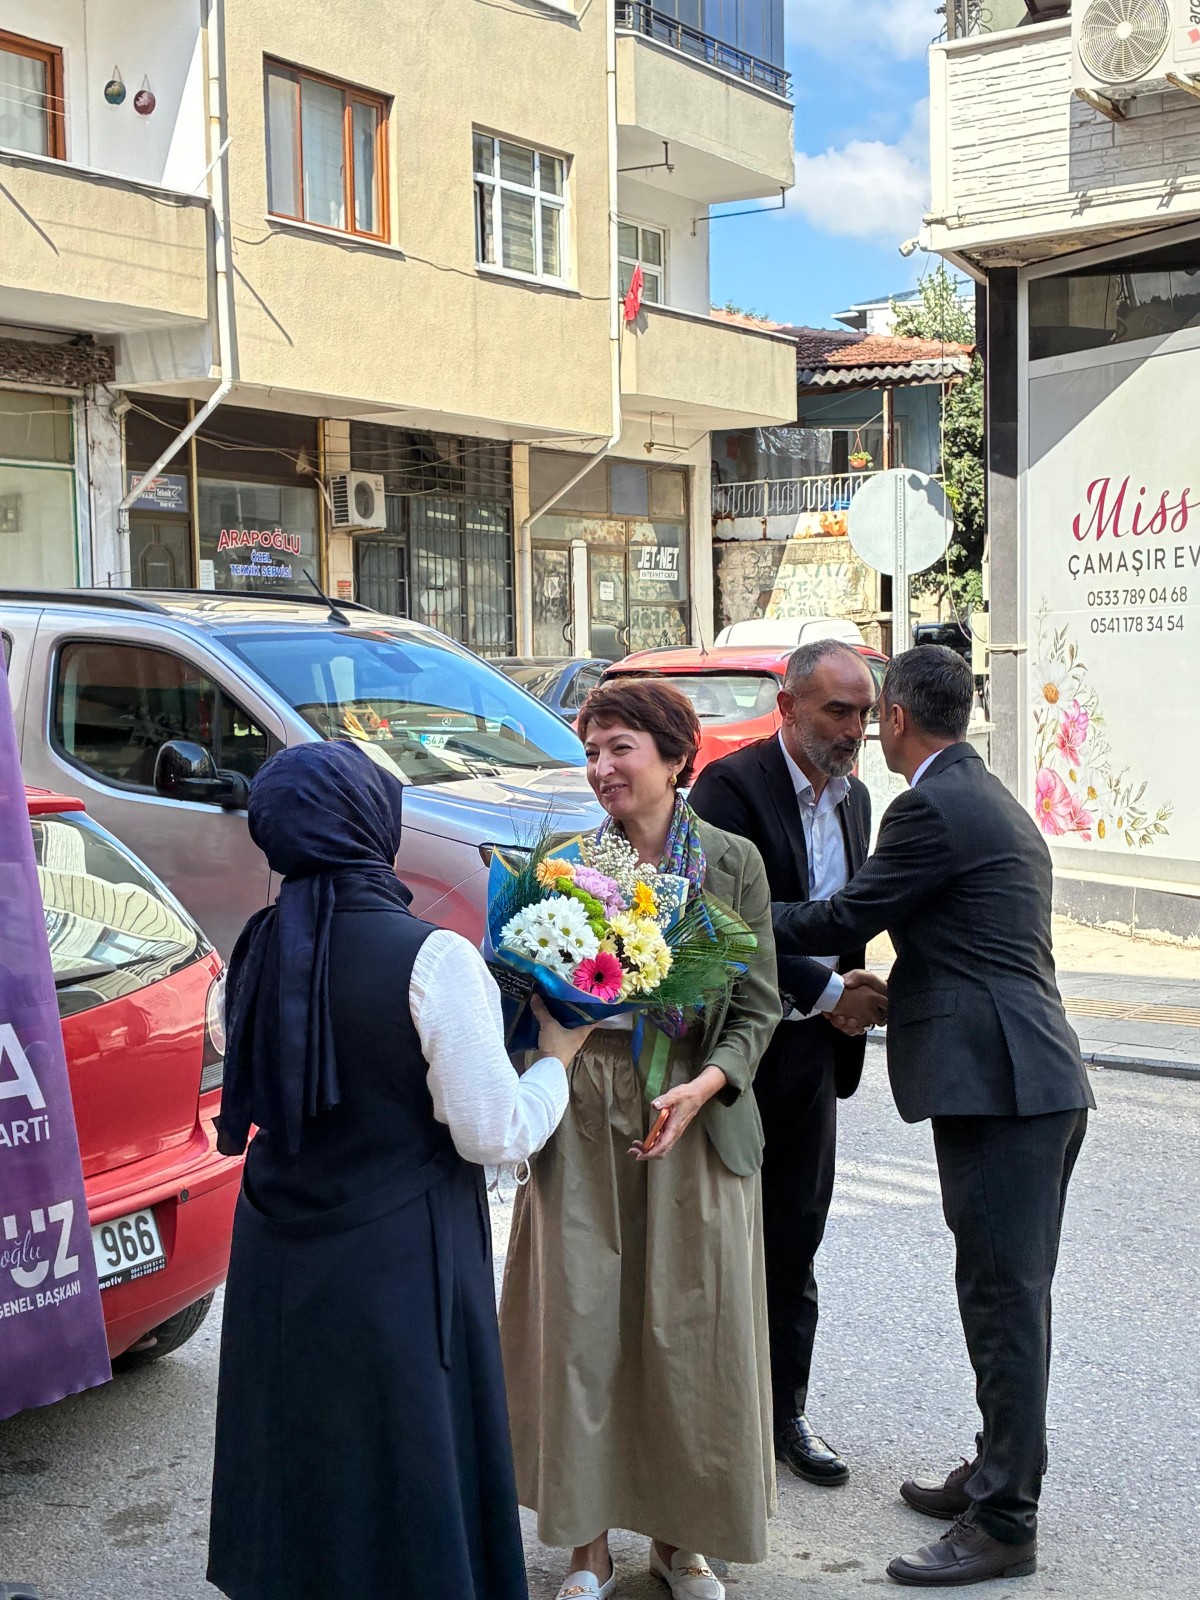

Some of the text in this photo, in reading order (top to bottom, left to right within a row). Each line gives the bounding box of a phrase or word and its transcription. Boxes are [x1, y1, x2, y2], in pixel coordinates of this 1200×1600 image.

[1072, 475, 1200, 541] Miss
[217, 528, 301, 556] ARAPOĞLU
[250, 549, 272, 563] ÖZEL
[229, 563, 261, 577] TEKNİK
[261, 564, 292, 578] SERVİSİ
[1068, 548, 1166, 580] ÇAMAŞIR
[1087, 586, 1188, 606] 0533 789 04 68
[1090, 615, 1184, 633] 0541 178 34 54
[101, 1215, 155, 1267] 966
[35, 1279, 81, 1307] BAŞKANI
